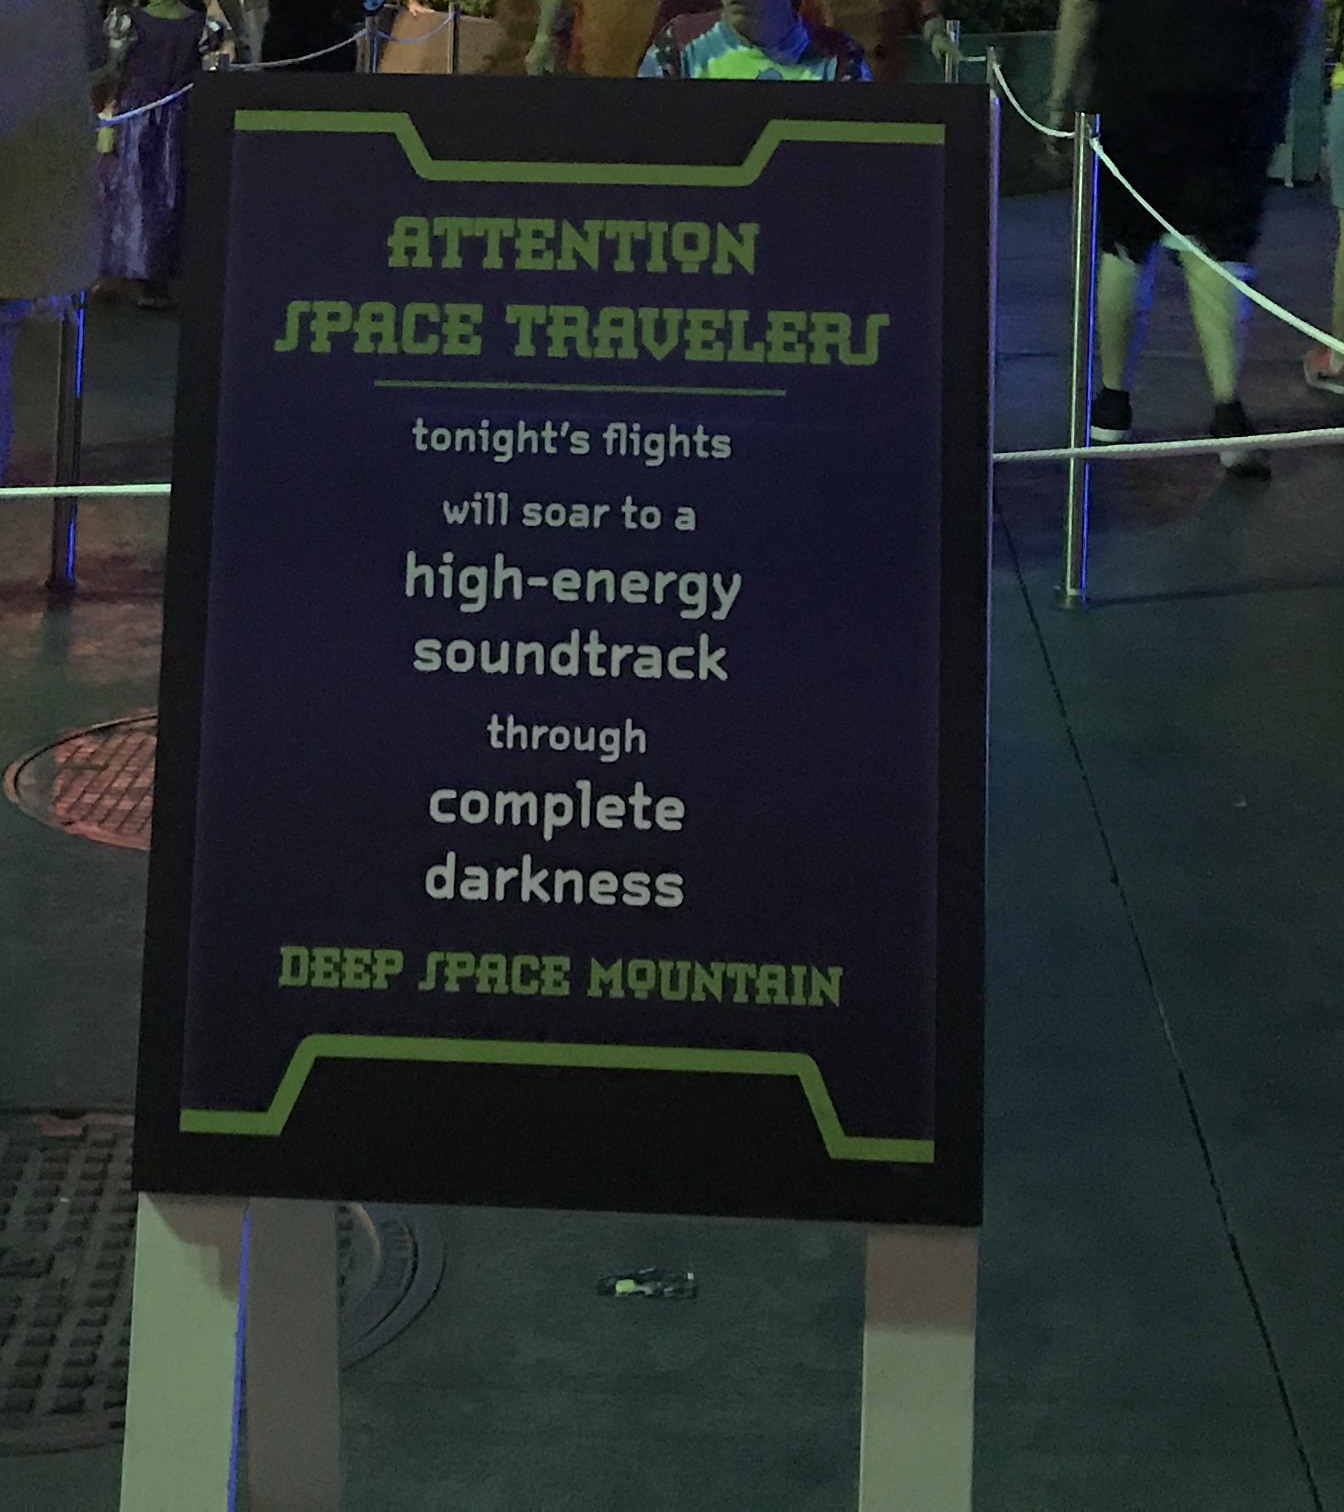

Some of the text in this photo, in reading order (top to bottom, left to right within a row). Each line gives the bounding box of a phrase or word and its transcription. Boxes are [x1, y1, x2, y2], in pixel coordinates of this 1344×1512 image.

[388, 217, 760, 276] ATTENTION
[275, 301, 891, 367] SPACE TRAVELERS
[413, 420, 732, 468] tonight's flights
[444, 492, 697, 532] will soar to a
[406, 551, 743, 622] high-energy
[414, 629, 729, 682] soundtrack
[487, 715, 647, 764] through
[430, 780, 686, 842] complete
[426, 852, 685, 909] darkness
[279, 946, 844, 1007] DEEP SPACE MOUNTAIN
